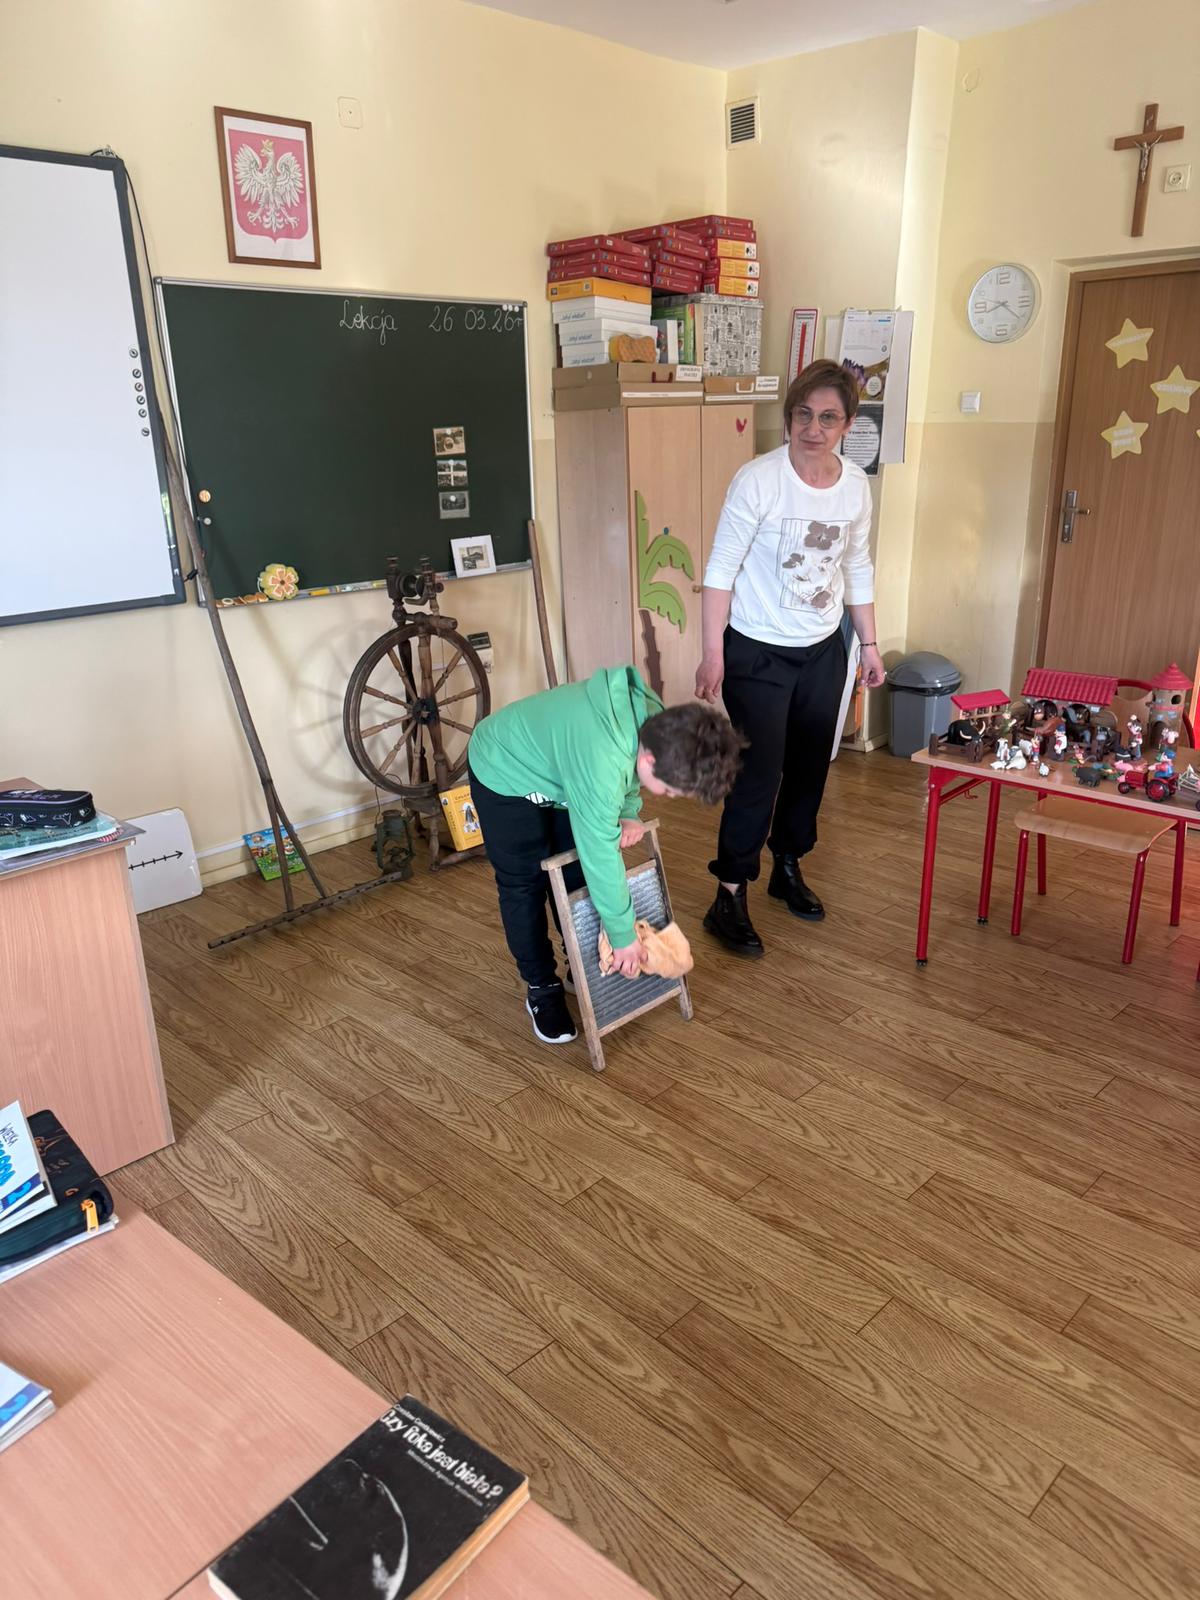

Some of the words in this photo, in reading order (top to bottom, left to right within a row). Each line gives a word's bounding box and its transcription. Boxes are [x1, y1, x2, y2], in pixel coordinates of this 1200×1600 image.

[339, 299, 398, 345] Lekcja
[428, 304, 456, 332] 26
[380, 1409, 408, 1432] Czy
[425, 1444, 460, 1470] jest
[453, 1461, 503, 1499] biała?
